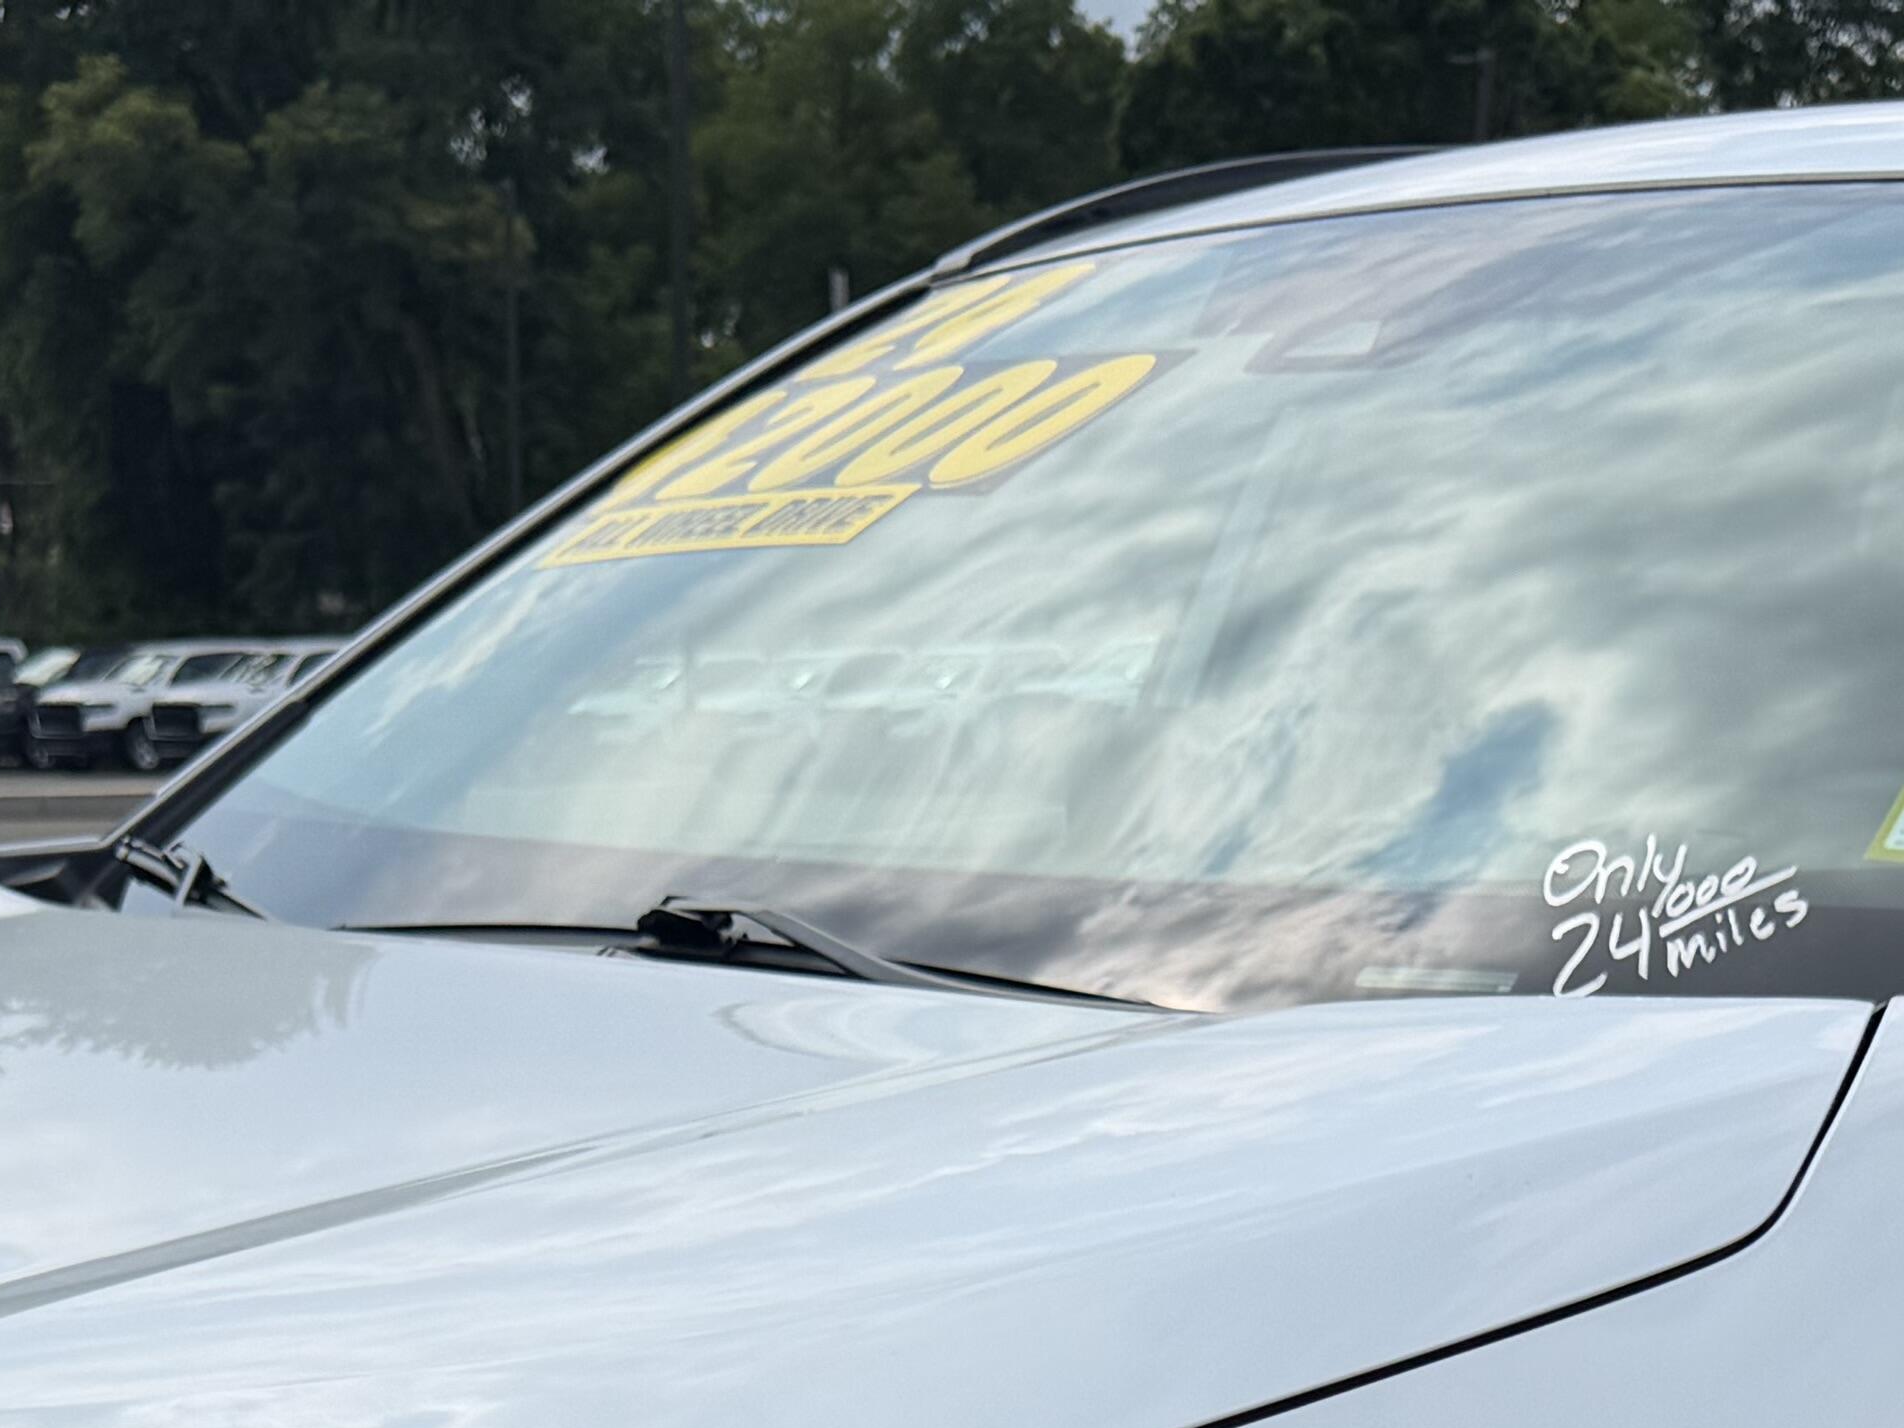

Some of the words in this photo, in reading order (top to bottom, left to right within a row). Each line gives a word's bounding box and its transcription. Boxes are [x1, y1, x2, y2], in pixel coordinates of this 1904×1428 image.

[630, 502, 770, 547] WHEEL
[743, 492, 894, 537] DRIVE
[1543, 833, 1688, 918] Only
[1666, 889, 1809, 978] miles
